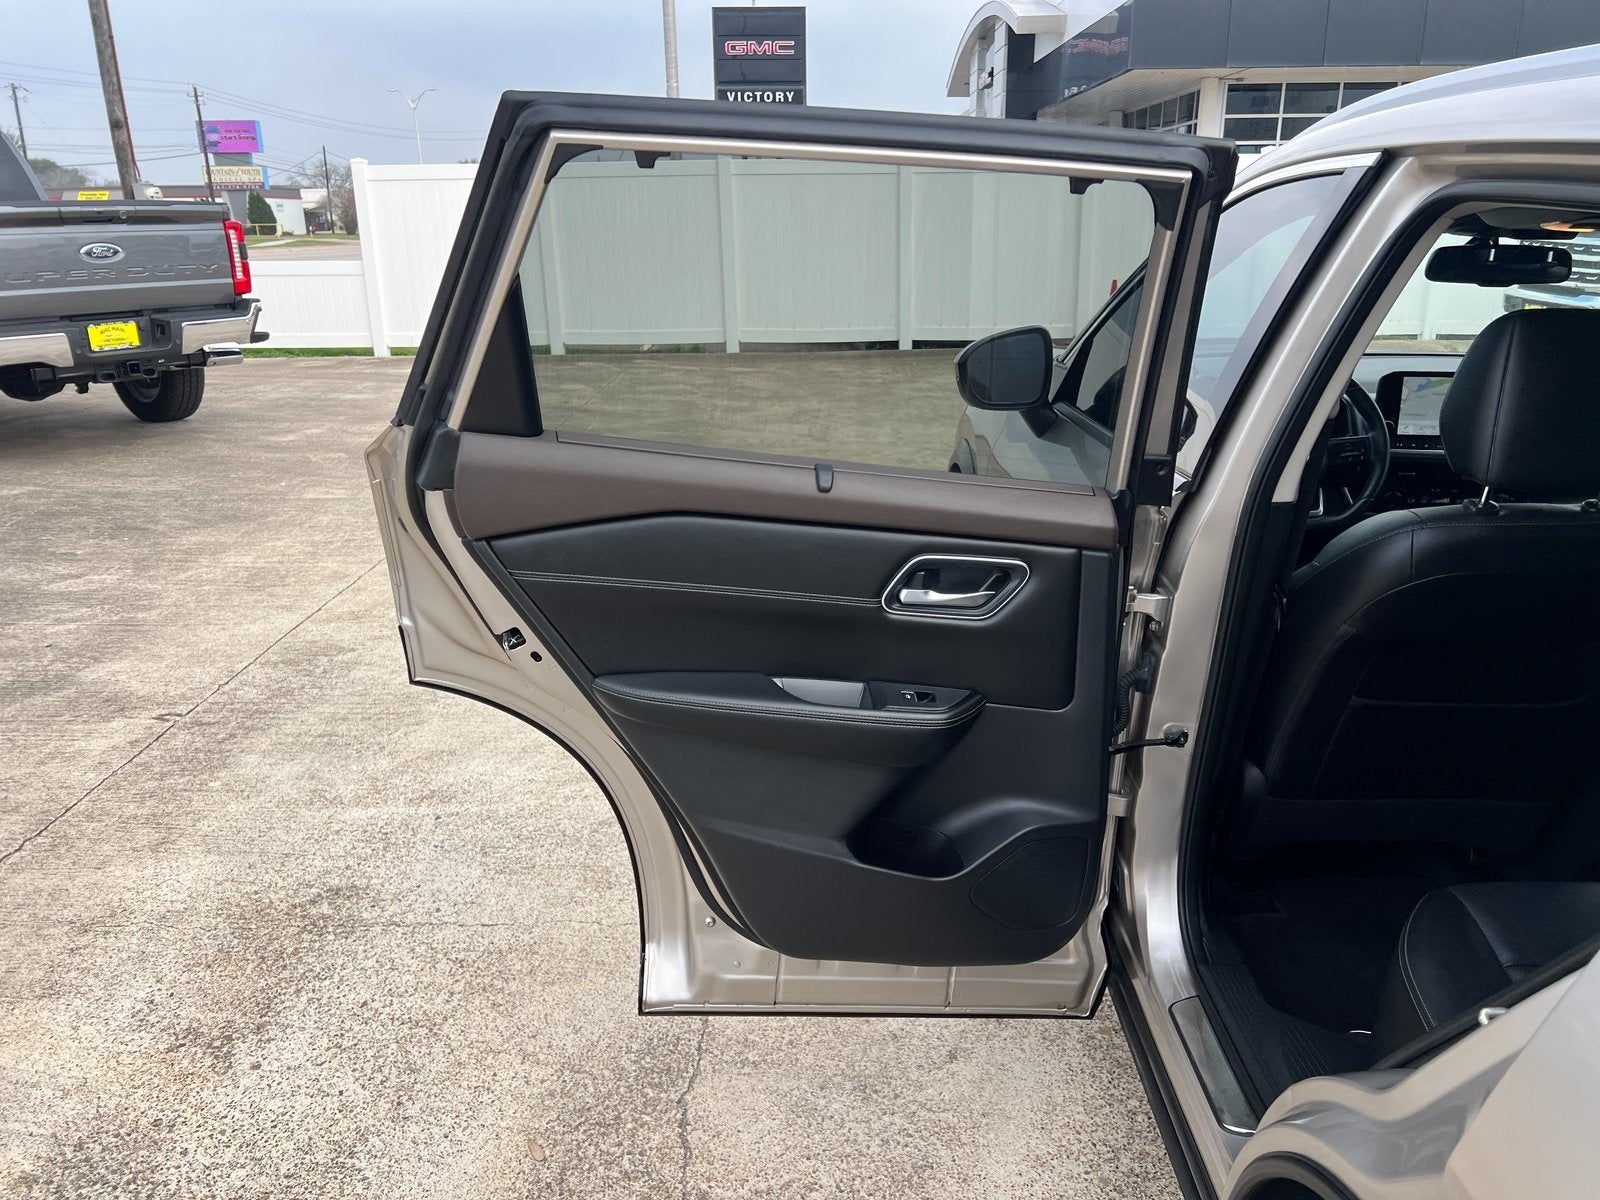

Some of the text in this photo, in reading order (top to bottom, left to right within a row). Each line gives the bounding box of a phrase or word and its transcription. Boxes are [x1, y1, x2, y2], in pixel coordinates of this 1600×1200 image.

[724, 40, 795, 56] GMC
[726, 91, 795, 103] VICTORY
[210, 168, 234, 176] OUNTAIN
[90, 246, 114, 258] Ford
[3, 263, 219, 284] UPER DUTY
